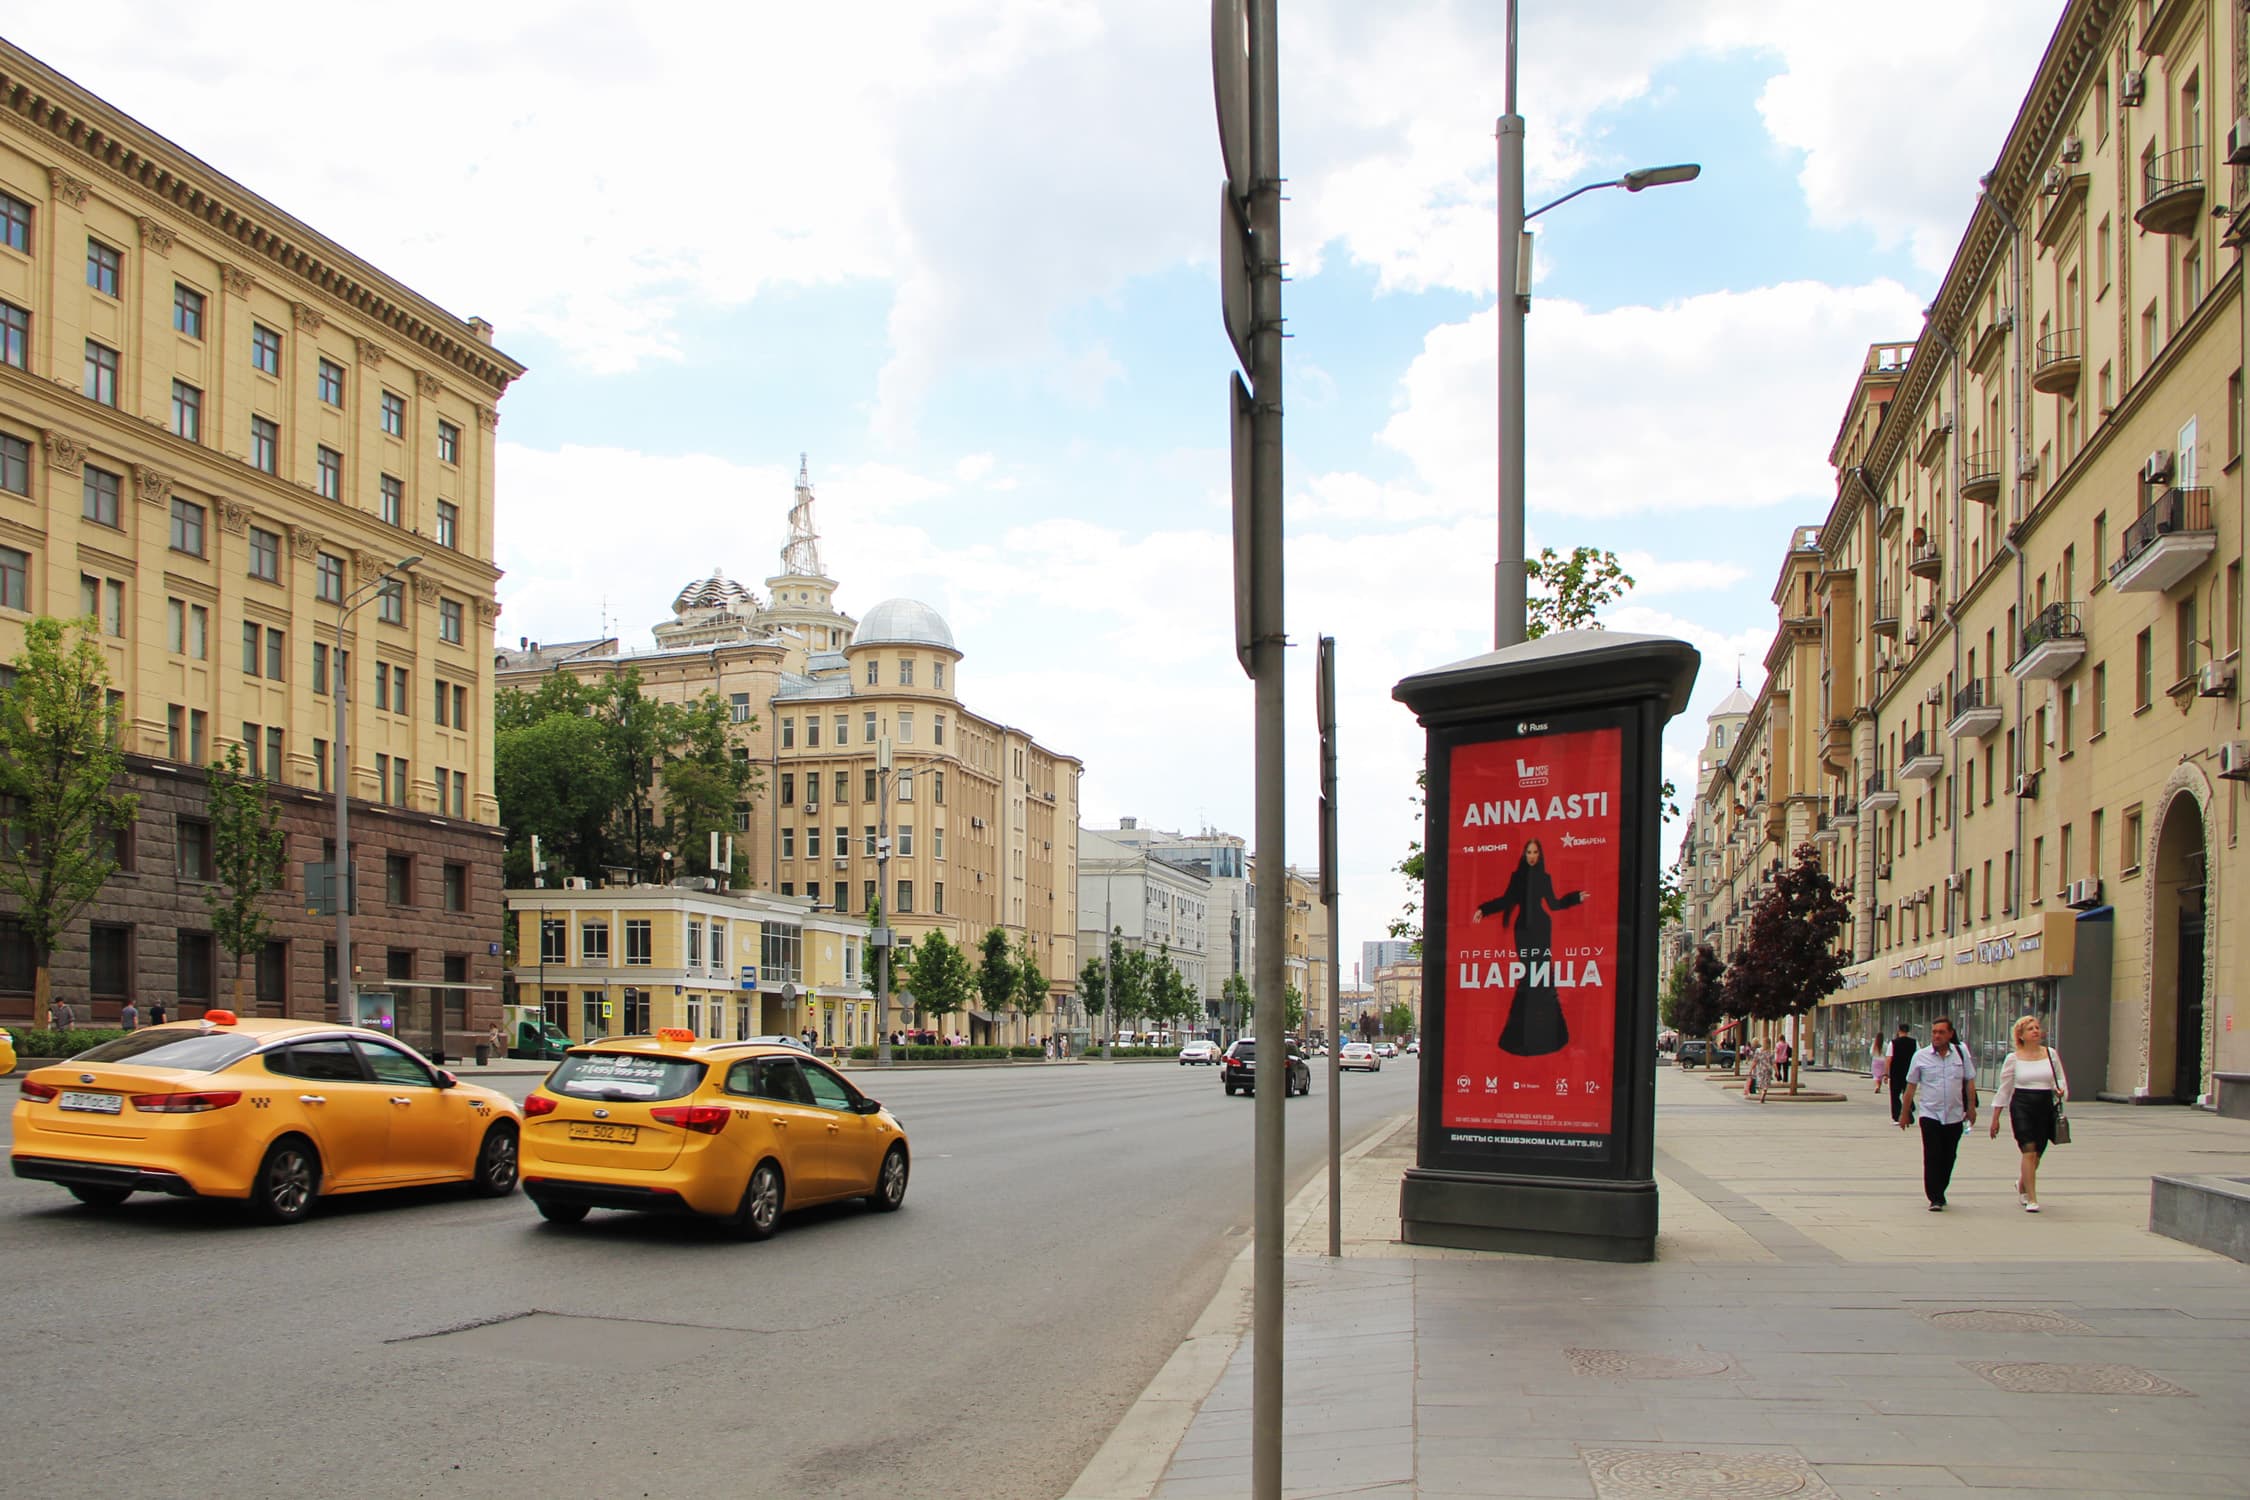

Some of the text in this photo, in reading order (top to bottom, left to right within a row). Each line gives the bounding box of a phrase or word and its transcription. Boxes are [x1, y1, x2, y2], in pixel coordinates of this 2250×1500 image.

[1529, 723, 1548, 731] Russ
[1463, 792, 1607, 827] ANNA ASTI
[1463, 843, 1508, 854] 14 ИЮНЯ
[1460, 946, 1604, 959] ПРЕМЬЕРА ШОУ
[1460, 960, 1603, 989] ЦАРИЦА
[1585, 1080, 1600, 1094] 12+
[594, 1126, 613, 1138] 502
[1451, 1134, 1486, 1142] БИЛЕТЫ
[1494, 1135, 1546, 1145] КЕШБЭКОМ
[1546, 1138, 1603, 1148] LIVE.MTS.RU
